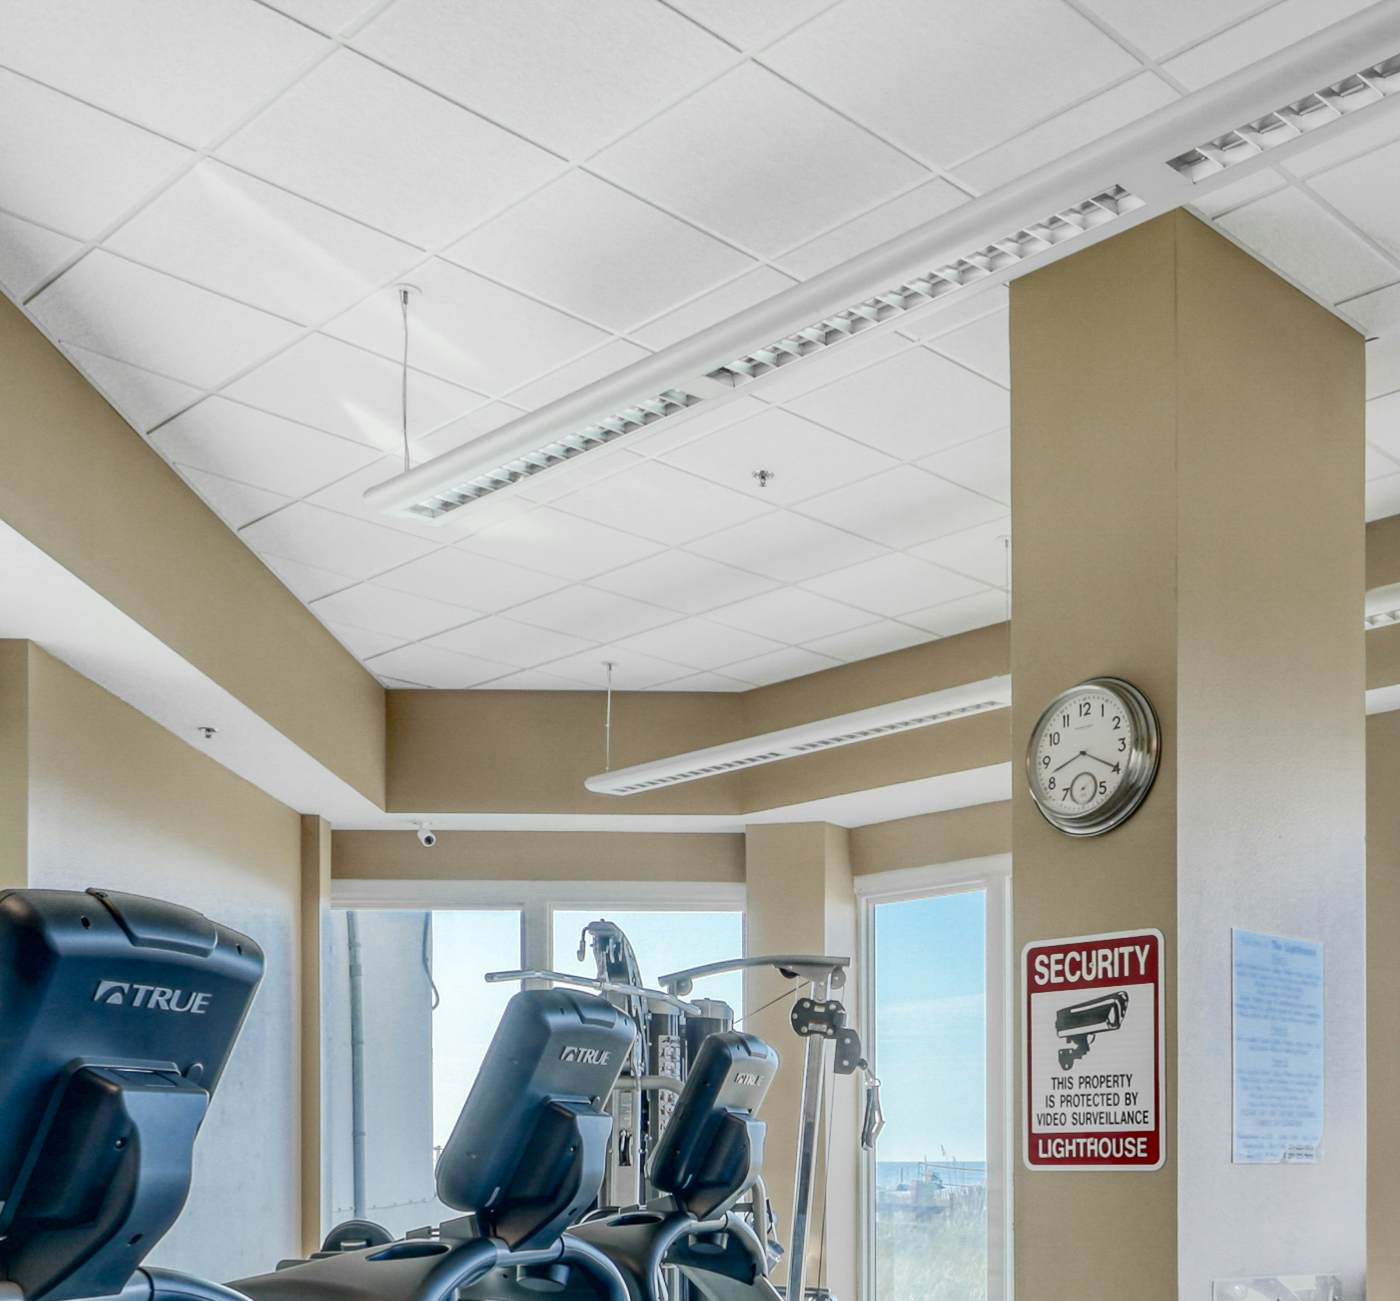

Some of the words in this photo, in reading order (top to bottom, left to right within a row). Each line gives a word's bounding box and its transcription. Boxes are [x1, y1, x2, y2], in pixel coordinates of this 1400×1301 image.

[1079, 702, 1092, 717] 12
[1062, 714, 1070, 728] 11
[1112, 715, 1121, 730] 2
[1049, 731, 1060, 747] 10
[1118, 737, 1126, 752] 3
[1042, 755, 1051, 769] 9
[1111, 762, 1120, 774] 4
[1048, 776, 1056, 790] 8
[1099, 781, 1107, 795] 5
[1062, 787, 1071, 802] 7
[1034, 944, 1150, 986] SECURITY
[132, 984, 213, 1014] TRUE
[577, 1047, 612, 1066] TRUE
[1051, 1076, 1074, 1090] THIS
[1078, 1074, 1133, 1089] PROPERTY
[1045, 1095, 1055, 1108] IS
[1060, 1093, 1120, 1108] PROTECTED
[1124, 1092, 1138, 1106] BY
[1036, 1112, 1067, 1126] VIDEO
[1071, 1110, 1149, 1126] SURVEILLANCE
[1038, 1137, 1148, 1159] LIGHTHOUSE
